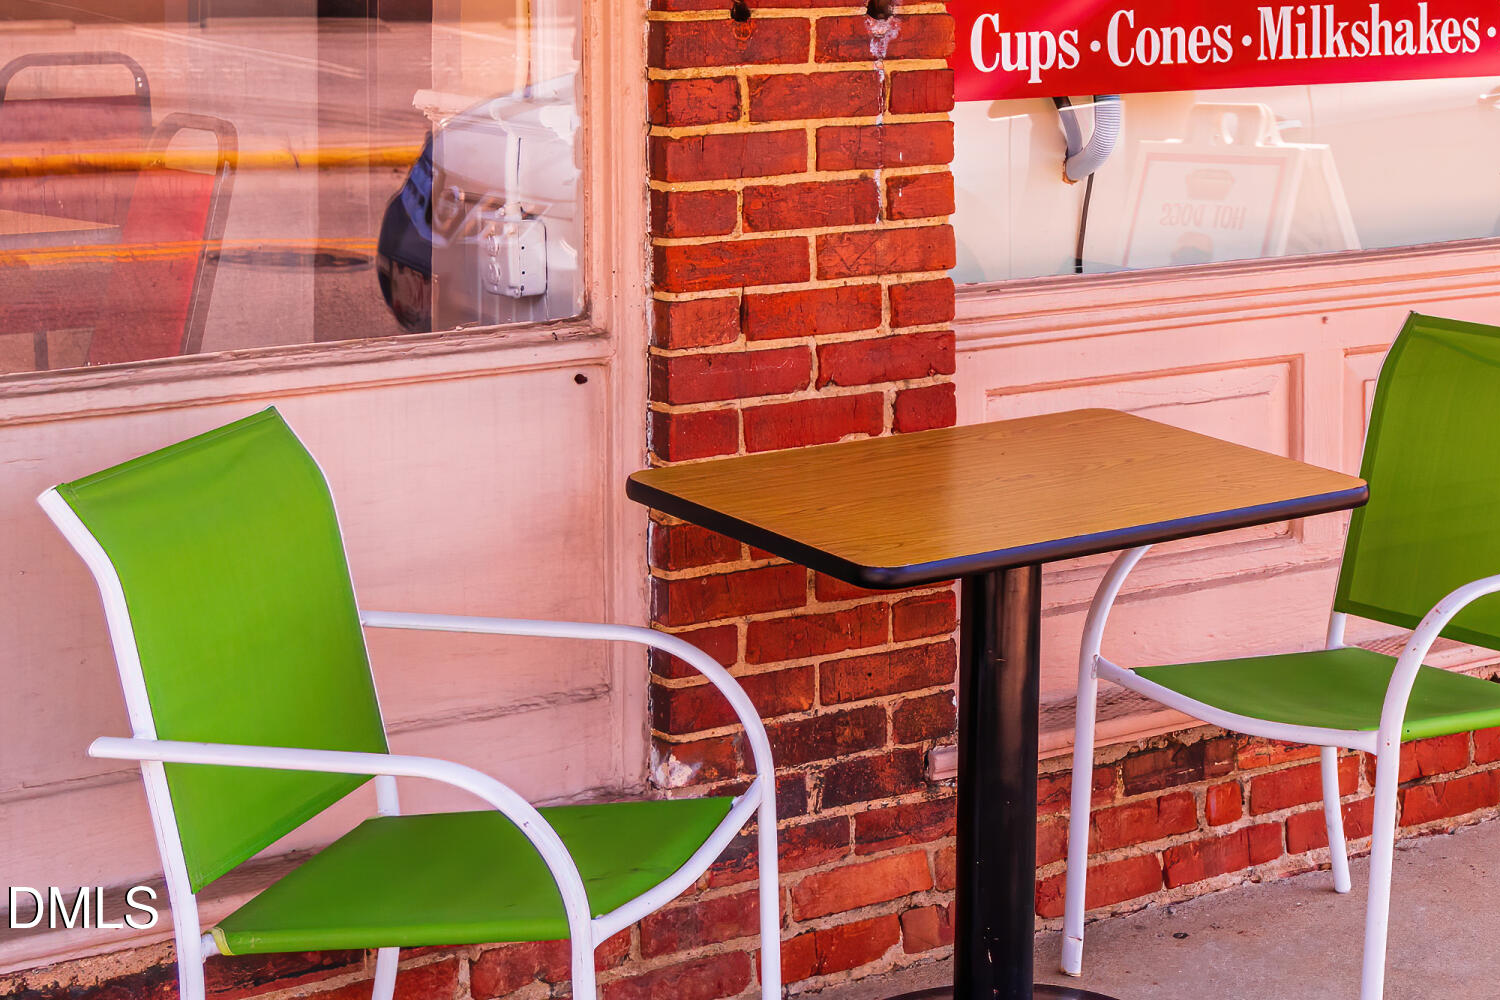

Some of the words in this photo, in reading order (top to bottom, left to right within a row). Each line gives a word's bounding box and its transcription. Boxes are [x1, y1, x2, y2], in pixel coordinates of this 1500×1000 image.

[970, 12, 1081, 84] Cups
[1106, 9, 1233, 67] Cones
[1257, 1, 1481, 61] Milkshakes
